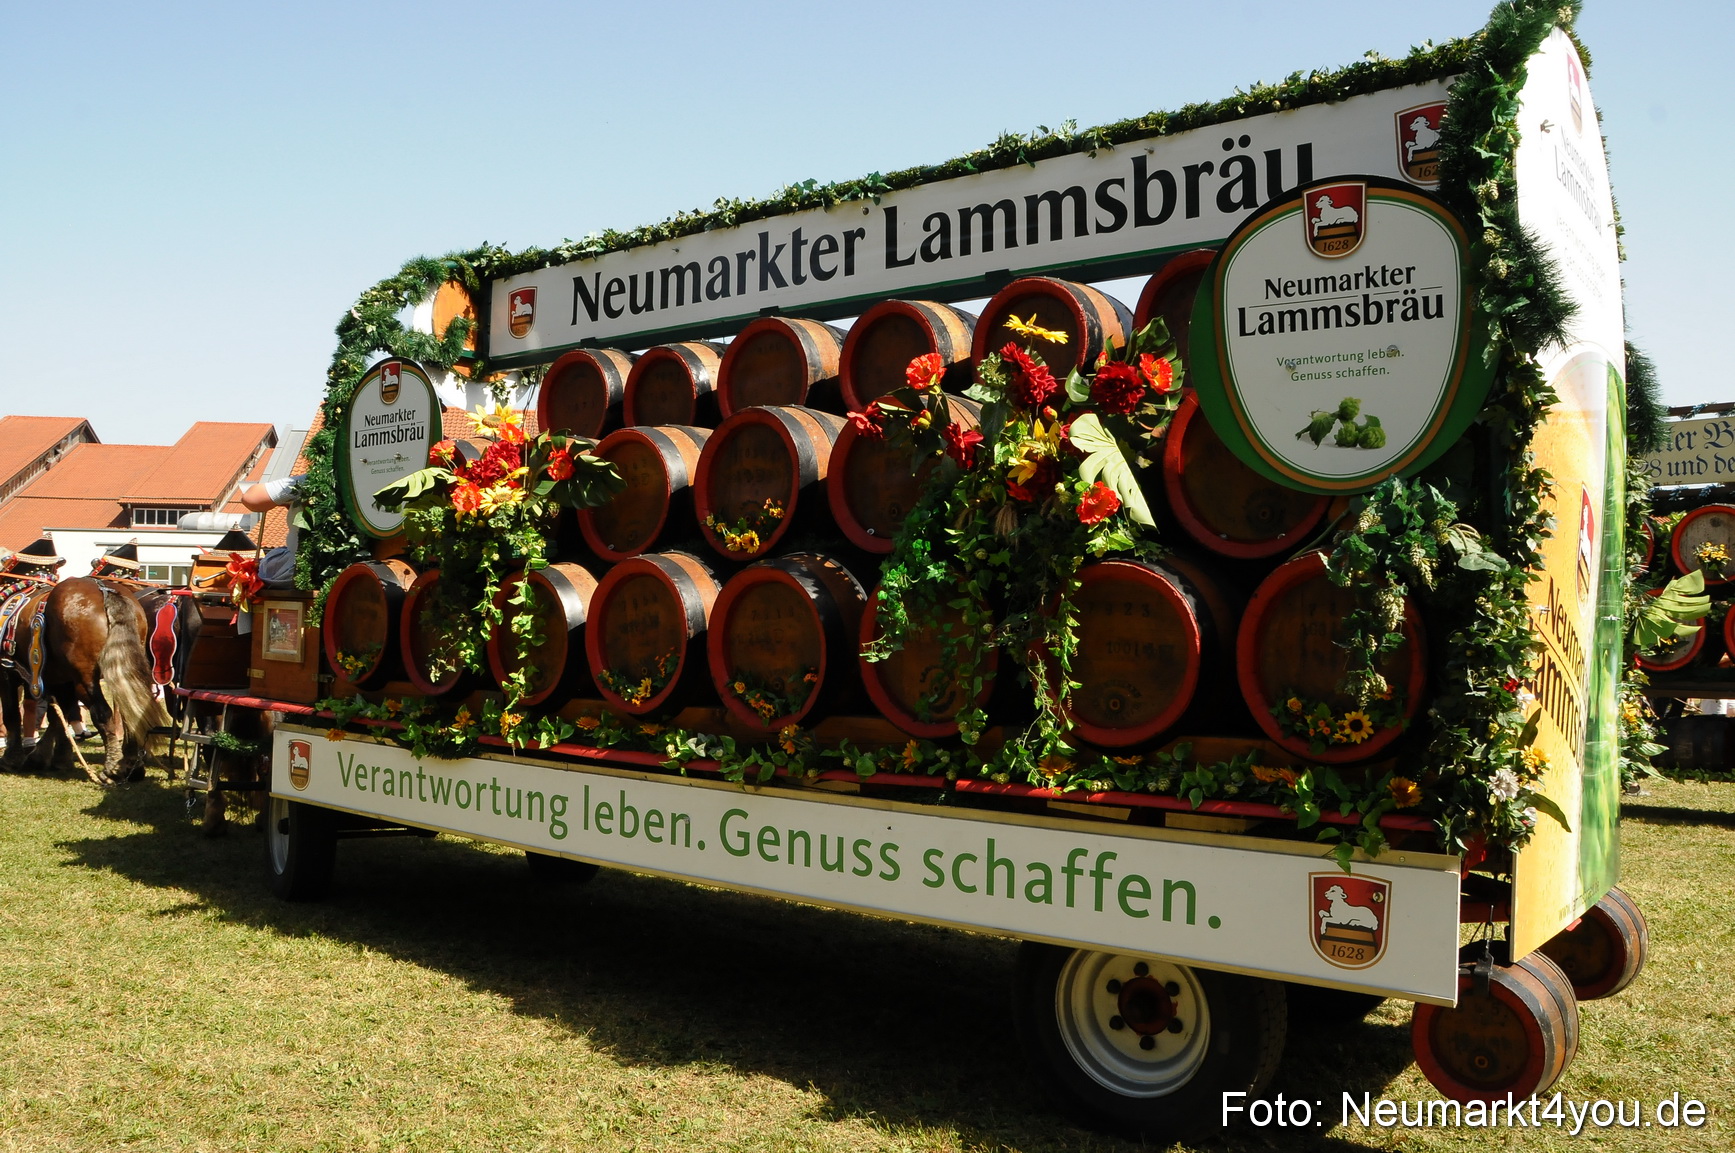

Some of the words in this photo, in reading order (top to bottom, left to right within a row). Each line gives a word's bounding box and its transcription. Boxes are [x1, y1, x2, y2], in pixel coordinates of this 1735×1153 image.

[1418, 165, 1439, 178] 162
[570, 227, 865, 326] Neumarkter
[883, 134, 1313, 269] Lammsbräu
[1322, 239, 1349, 252] 1628
[1264, 264, 1416, 300] Neumarkter
[1238, 288, 1444, 337] Lammsbräu
[1291, 370, 1332, 381] Genuss
[1336, 365, 1390, 378] schaffen.
[364, 409, 416, 428] Neumarkter
[354, 422, 424, 449] Lammsbräu
[1667, 454, 1708, 477] und
[337, 751, 569, 840] Verantwortung
[583, 784, 707, 851] leben.
[719, 808, 902, 882] Genuss
[921, 838, 1223, 930] schaffen.
[1330, 944, 1365, 961] 1628
